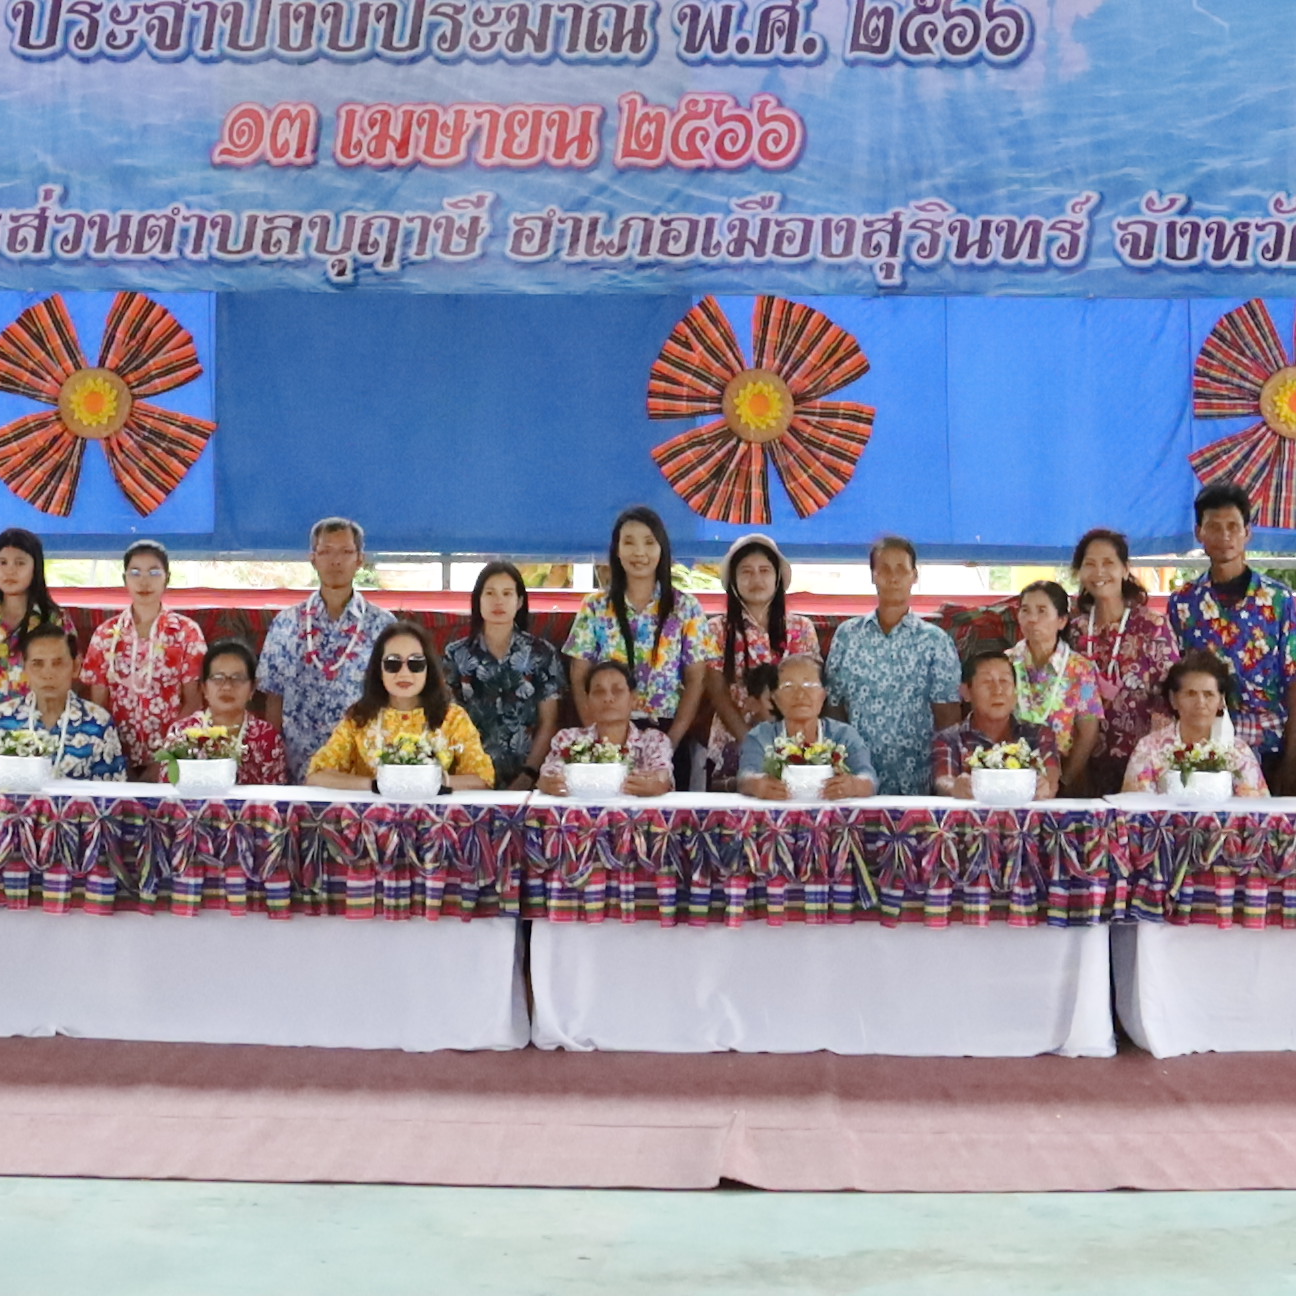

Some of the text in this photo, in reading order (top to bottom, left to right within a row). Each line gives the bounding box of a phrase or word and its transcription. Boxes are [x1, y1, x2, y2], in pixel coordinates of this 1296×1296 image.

[216, 96, 799, 163] ๑๓ เมษายน ๒๕๖๖
[507, 193, 1094, 280] อำเภอเมืองสุรินทร์
